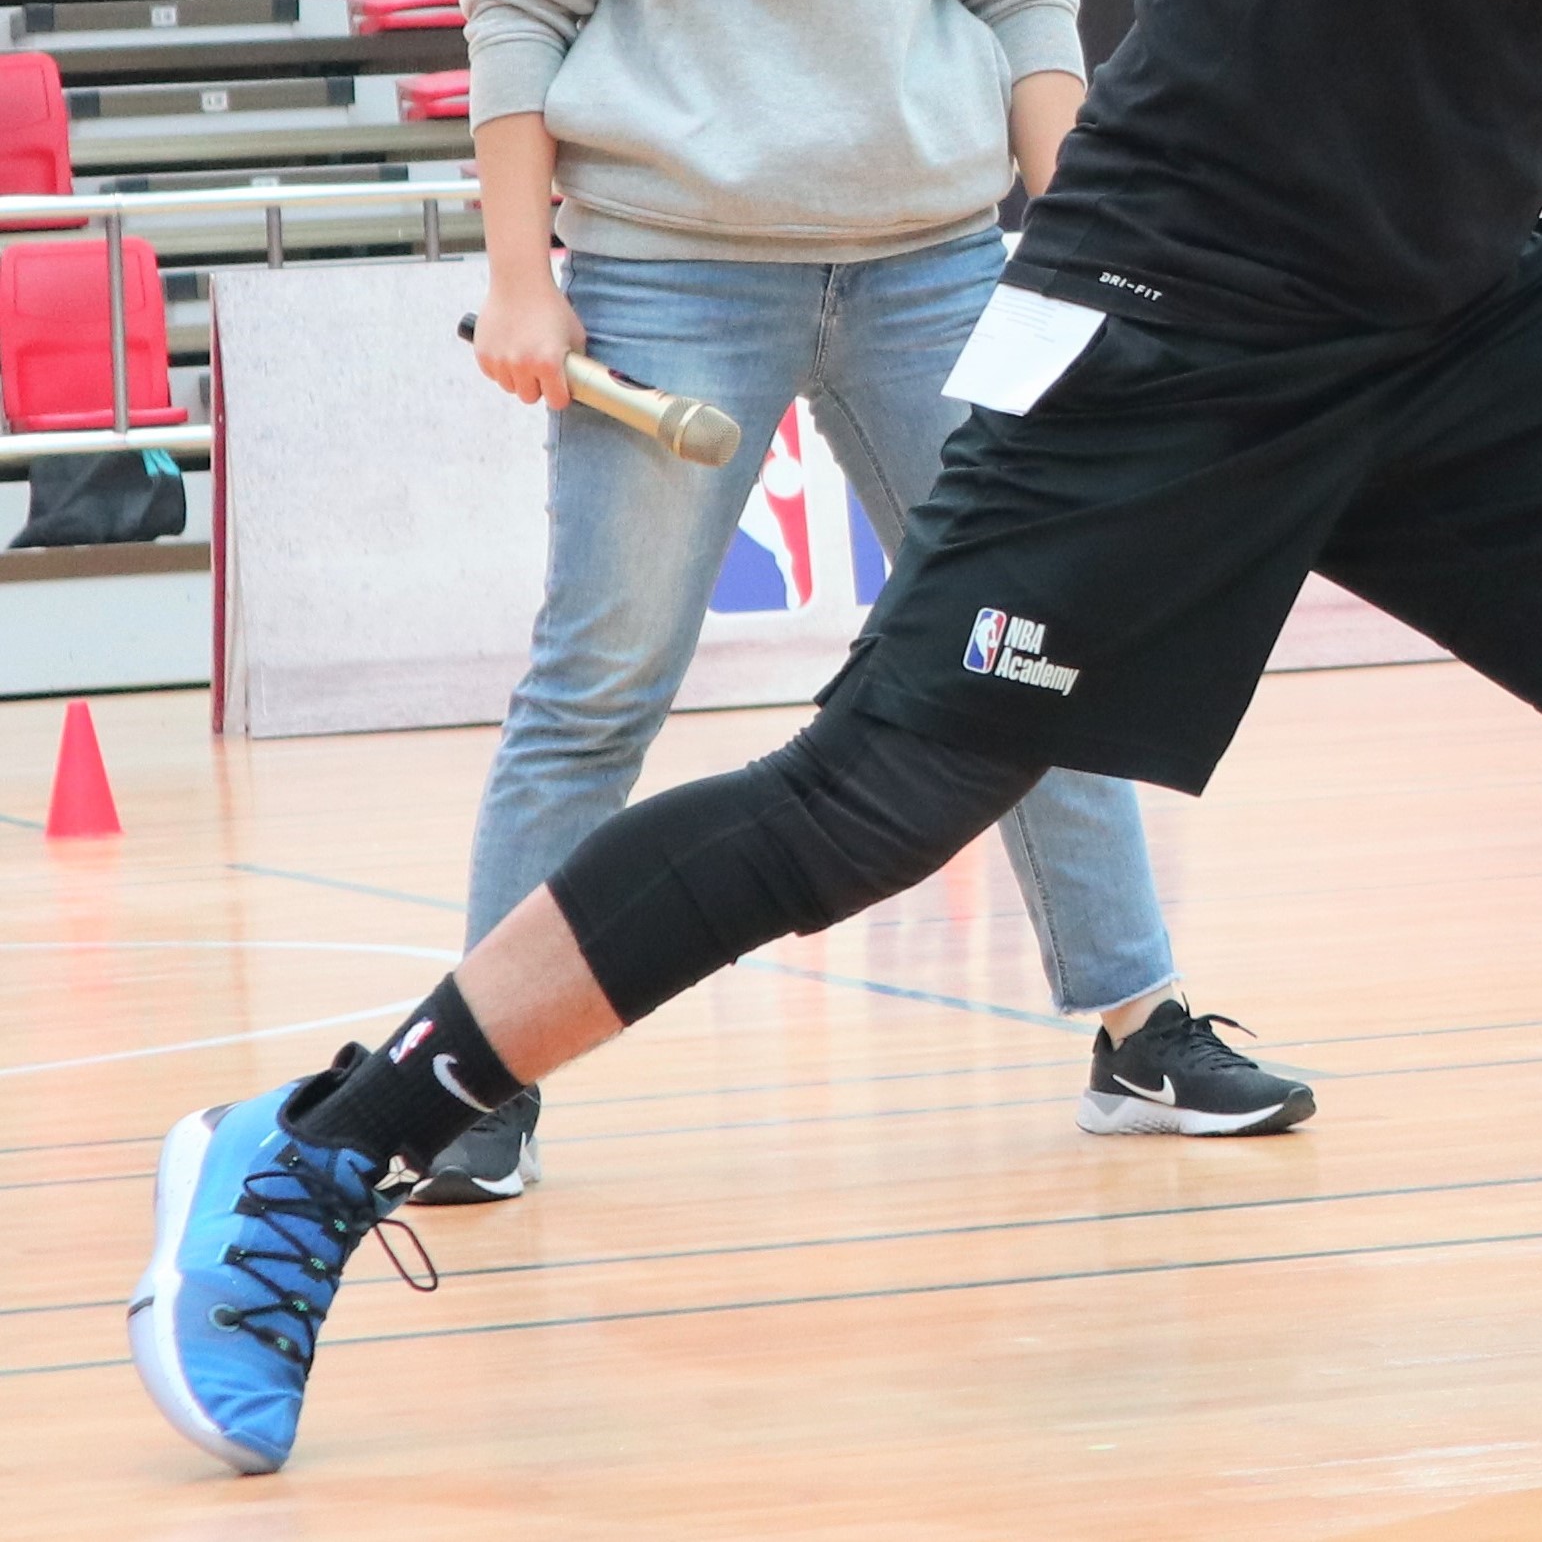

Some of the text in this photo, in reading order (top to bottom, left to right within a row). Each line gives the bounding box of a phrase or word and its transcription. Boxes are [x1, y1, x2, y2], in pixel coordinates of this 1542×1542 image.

[1099, 271, 1162, 301] DRI-FIT
[1004, 616, 1047, 654] NBA
[994, 646, 1080, 696] Academy
